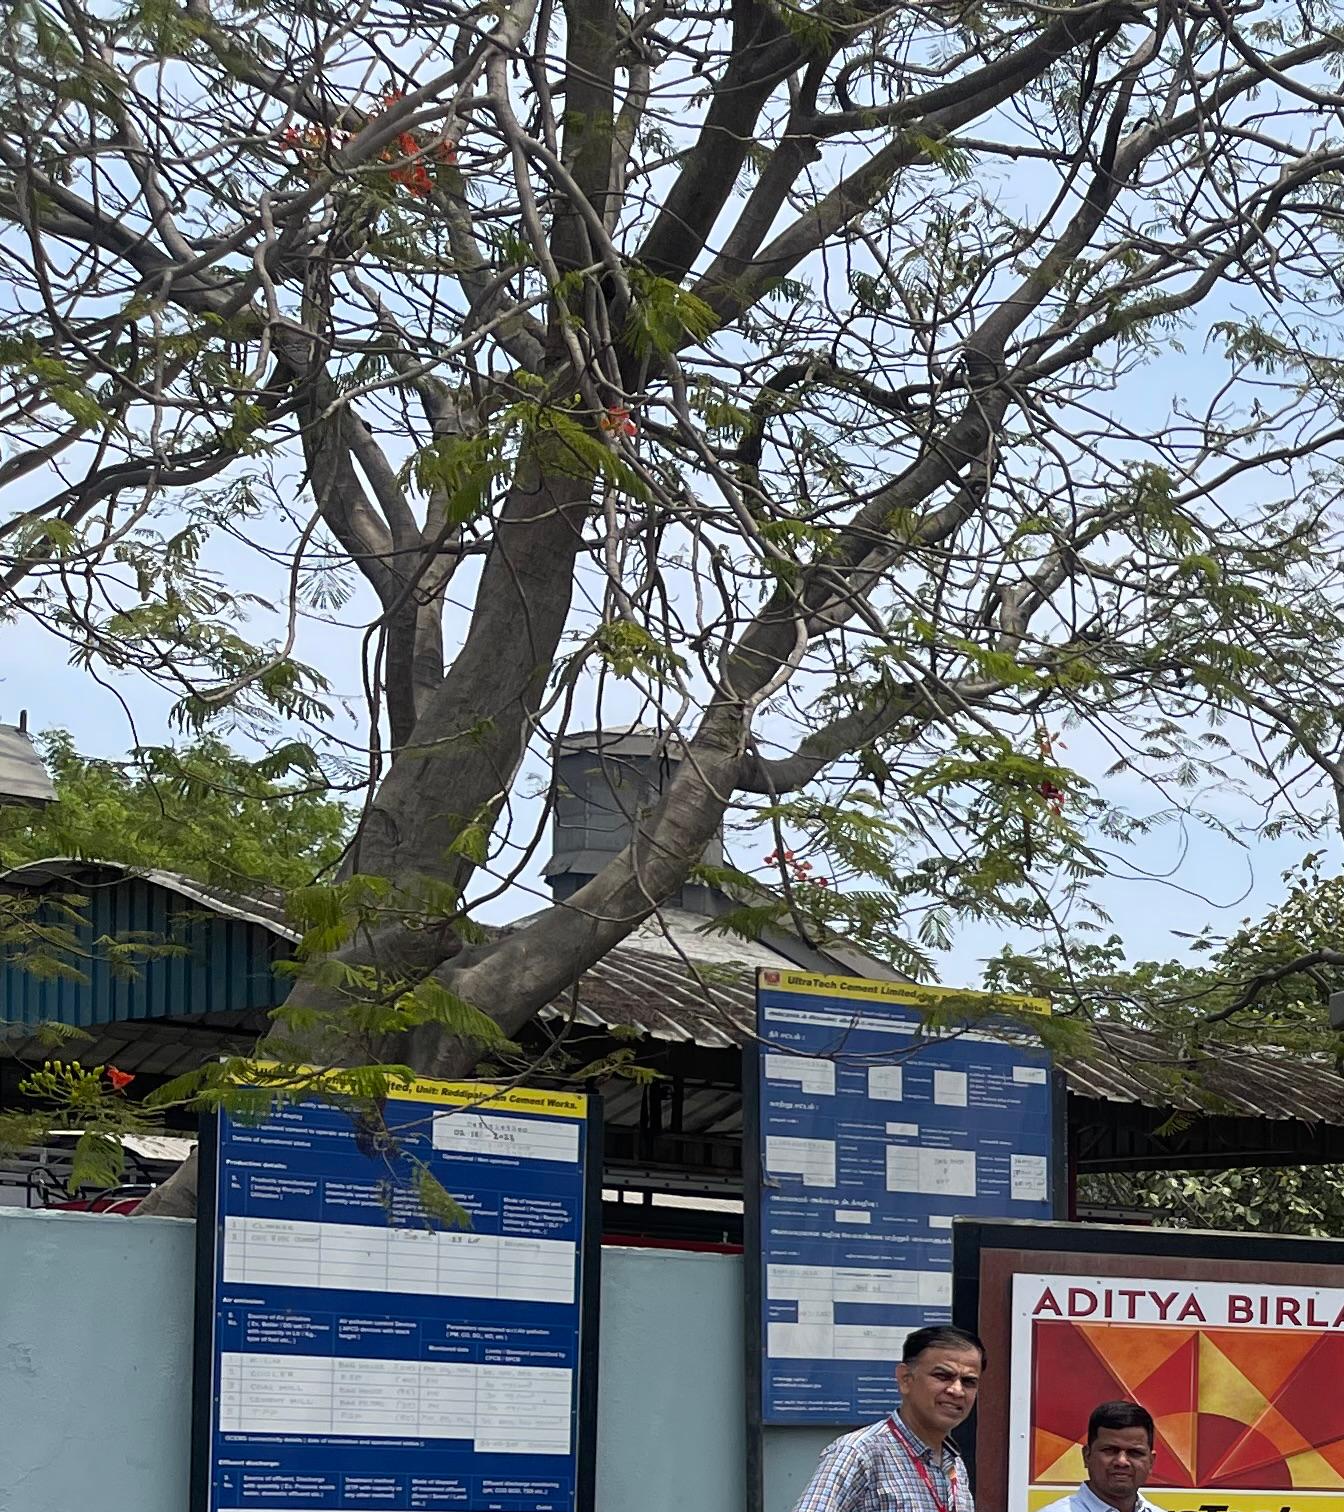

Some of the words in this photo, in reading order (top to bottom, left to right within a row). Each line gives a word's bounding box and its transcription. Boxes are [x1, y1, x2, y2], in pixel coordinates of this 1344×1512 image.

[787, 975, 837, 990] UltraTech
[839, 981, 878, 995] Cement
[415, 1084, 438, 1096] Unit:
[508, 1094, 545, 1106] Cement
[547, 1098, 578, 1110] Works.
[1032, 1286, 1207, 1322] ADITYA
